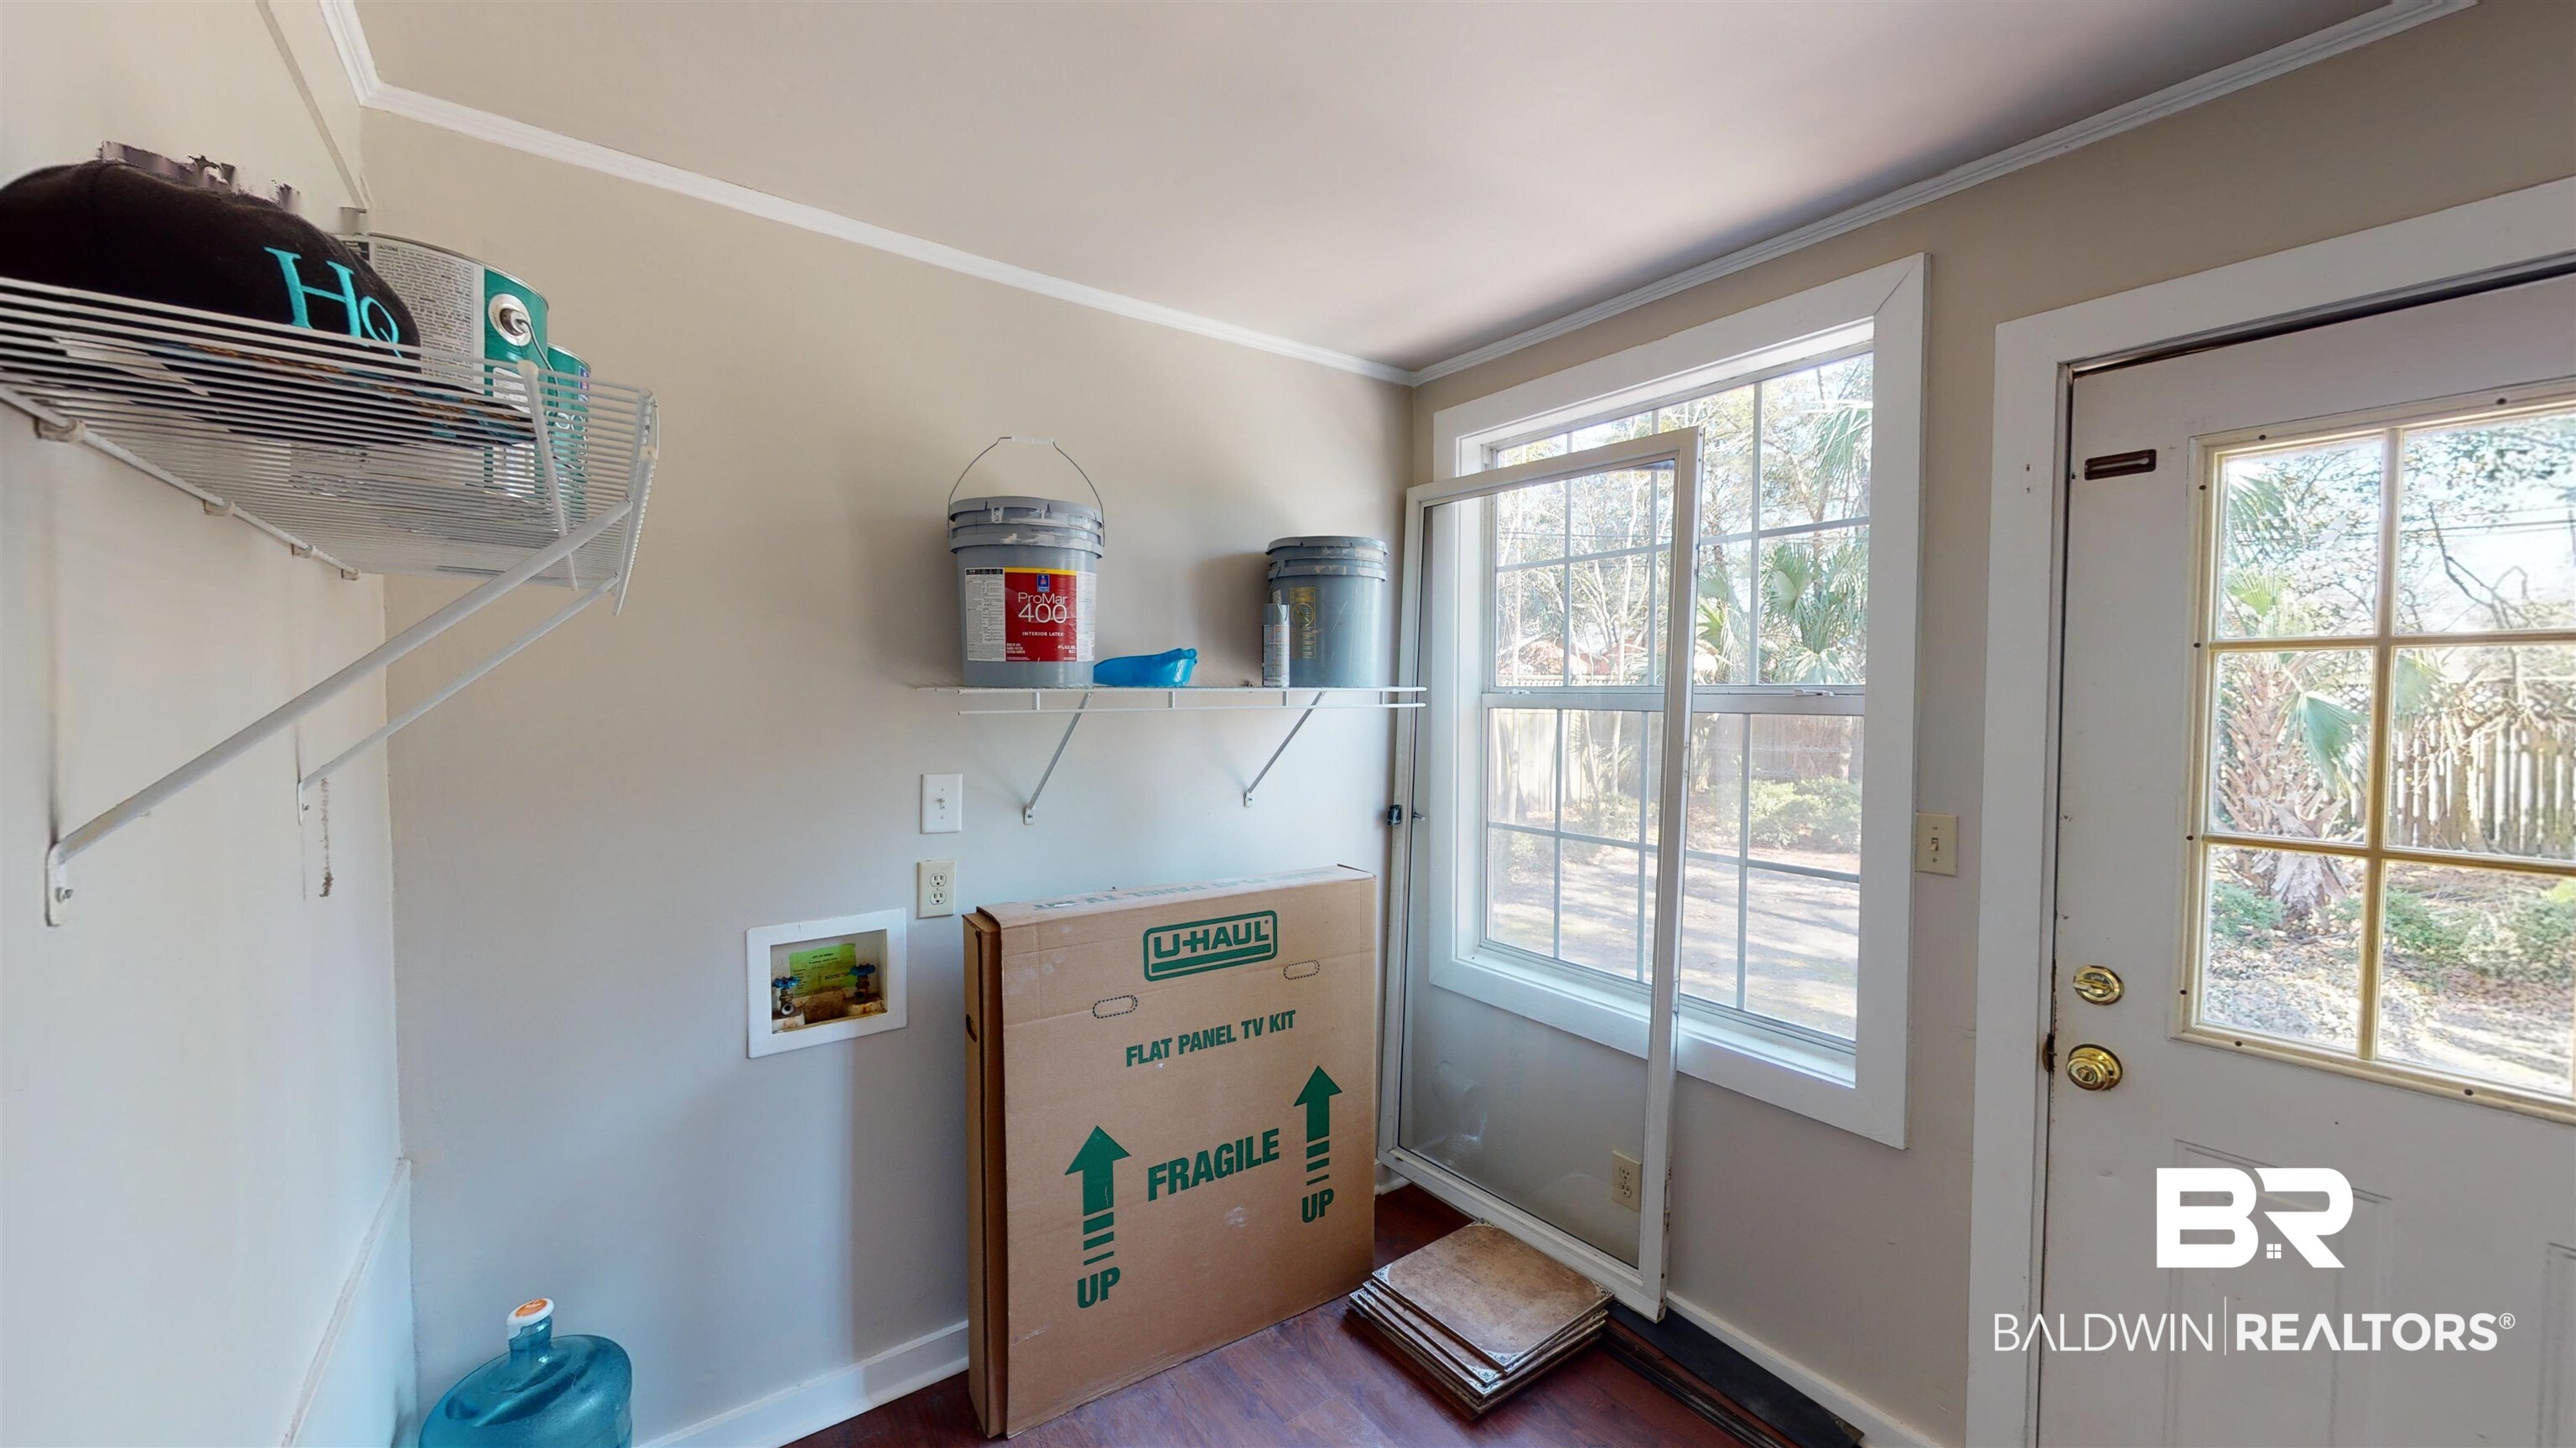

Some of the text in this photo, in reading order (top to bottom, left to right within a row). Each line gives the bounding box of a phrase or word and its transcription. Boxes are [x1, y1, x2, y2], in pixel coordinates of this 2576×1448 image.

[263, 247, 402, 358] HQ
[1018, 592, 1067, 605] ProMar
[1018, 603, 1067, 624] 400
[1153, 920, 1270, 959] U-HAUL
[1126, 1009, 1296, 1067] FLAT PANEL TV KIT
[1148, 1128, 1280, 1202] FRAGILE
[1301, 1188, 1334, 1223] UP
[1078, 1267, 1120, 1309] UP
